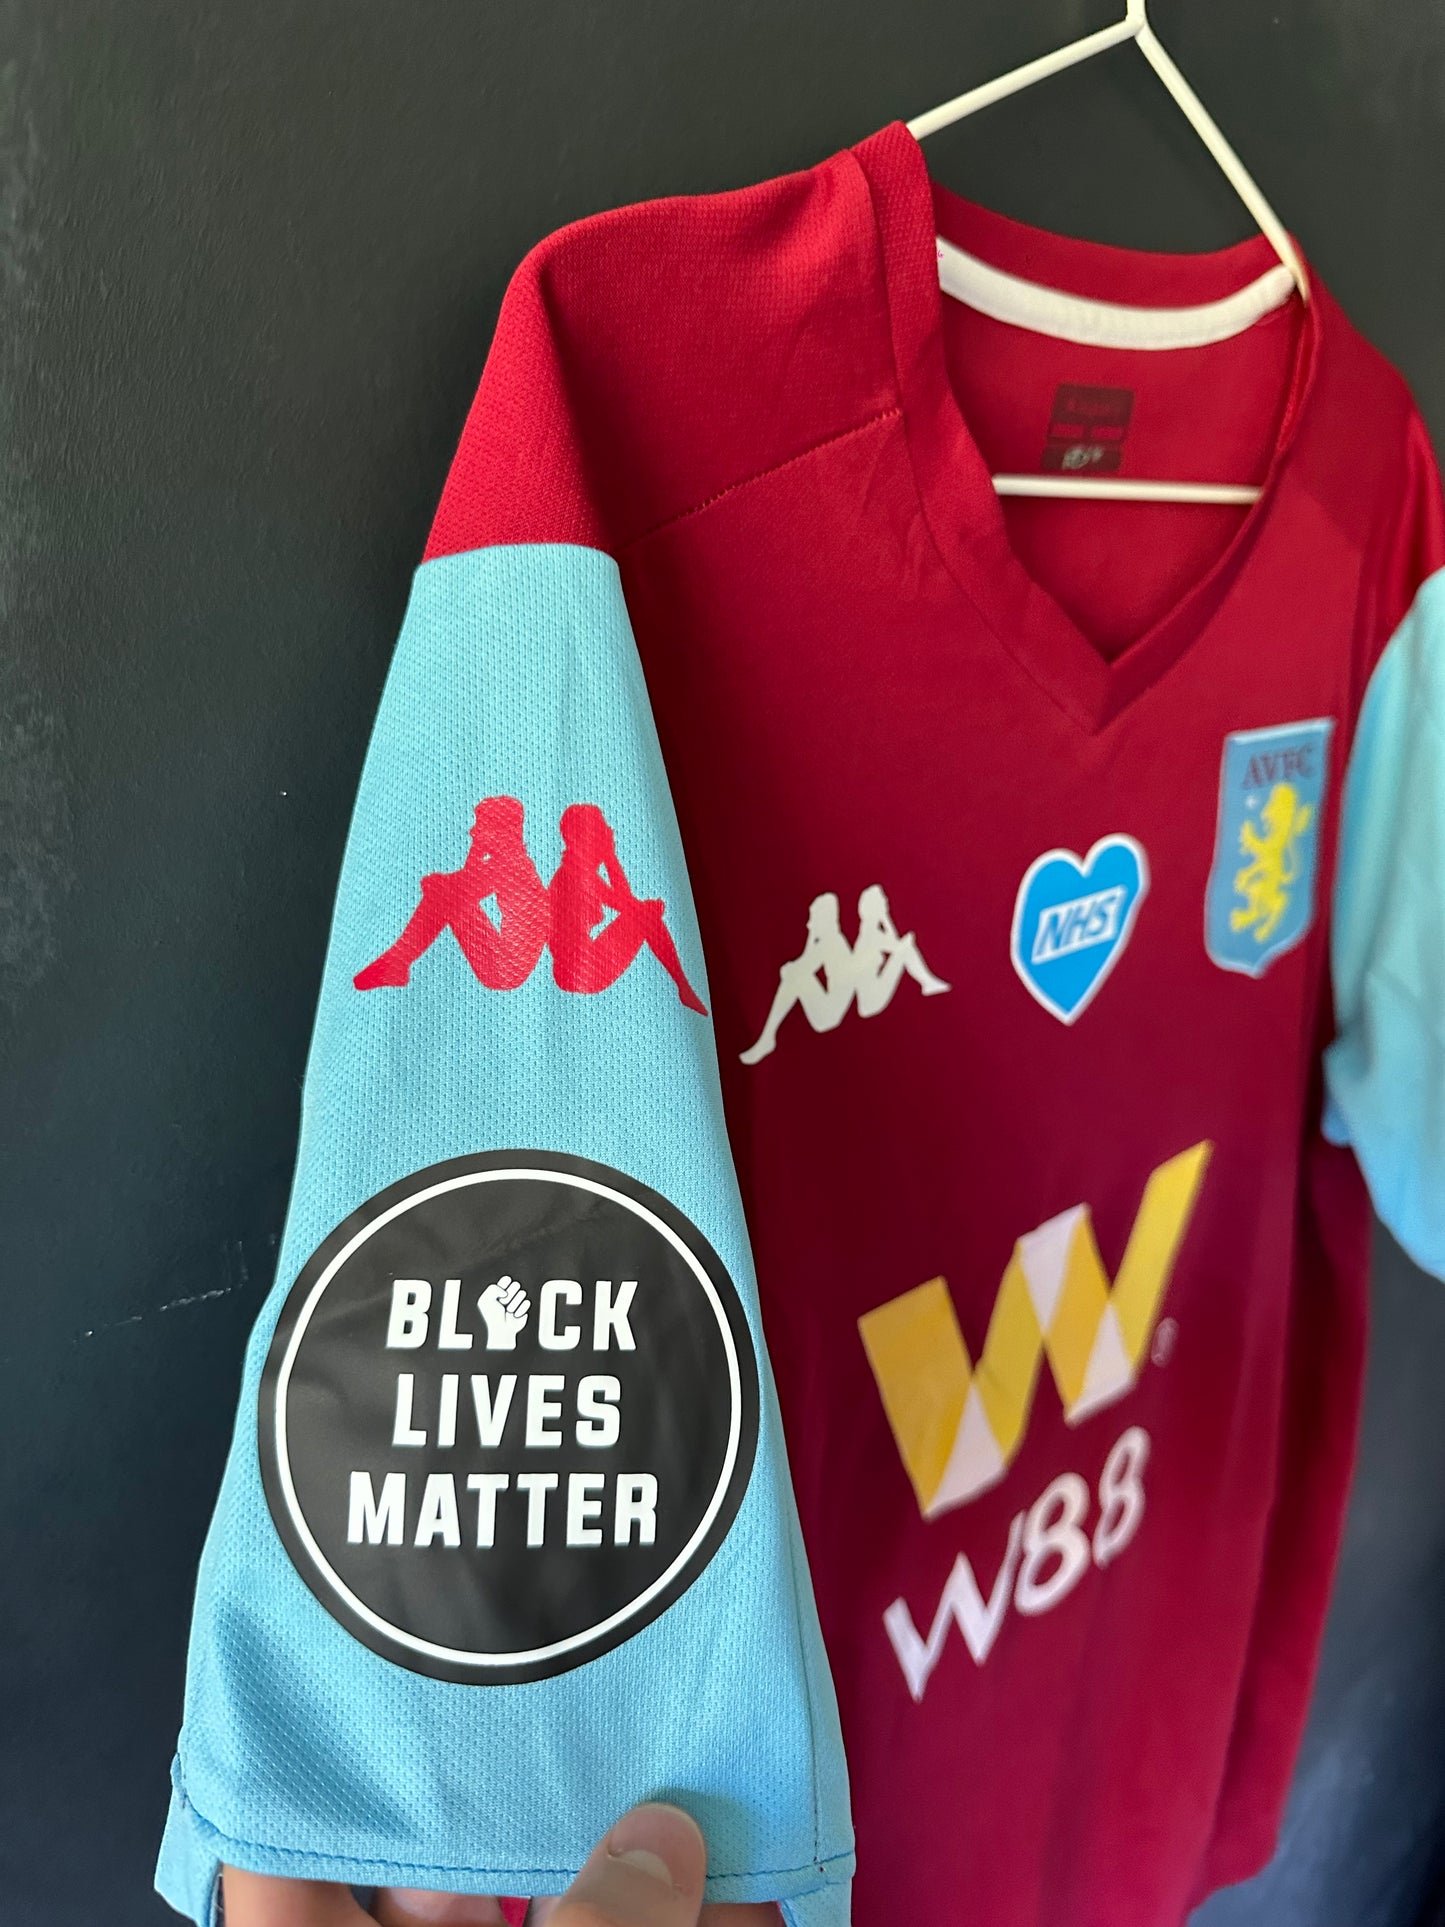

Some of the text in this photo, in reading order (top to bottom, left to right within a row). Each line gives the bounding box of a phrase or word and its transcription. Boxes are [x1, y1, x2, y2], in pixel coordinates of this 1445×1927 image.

[1035, 893, 1114, 958] NHS
[385, 1275, 638, 1351] BLCK
[392, 1373, 620, 1449] LIVES
[347, 1471, 658, 1549] MATTER
[882, 1426, 1150, 1702] W88
